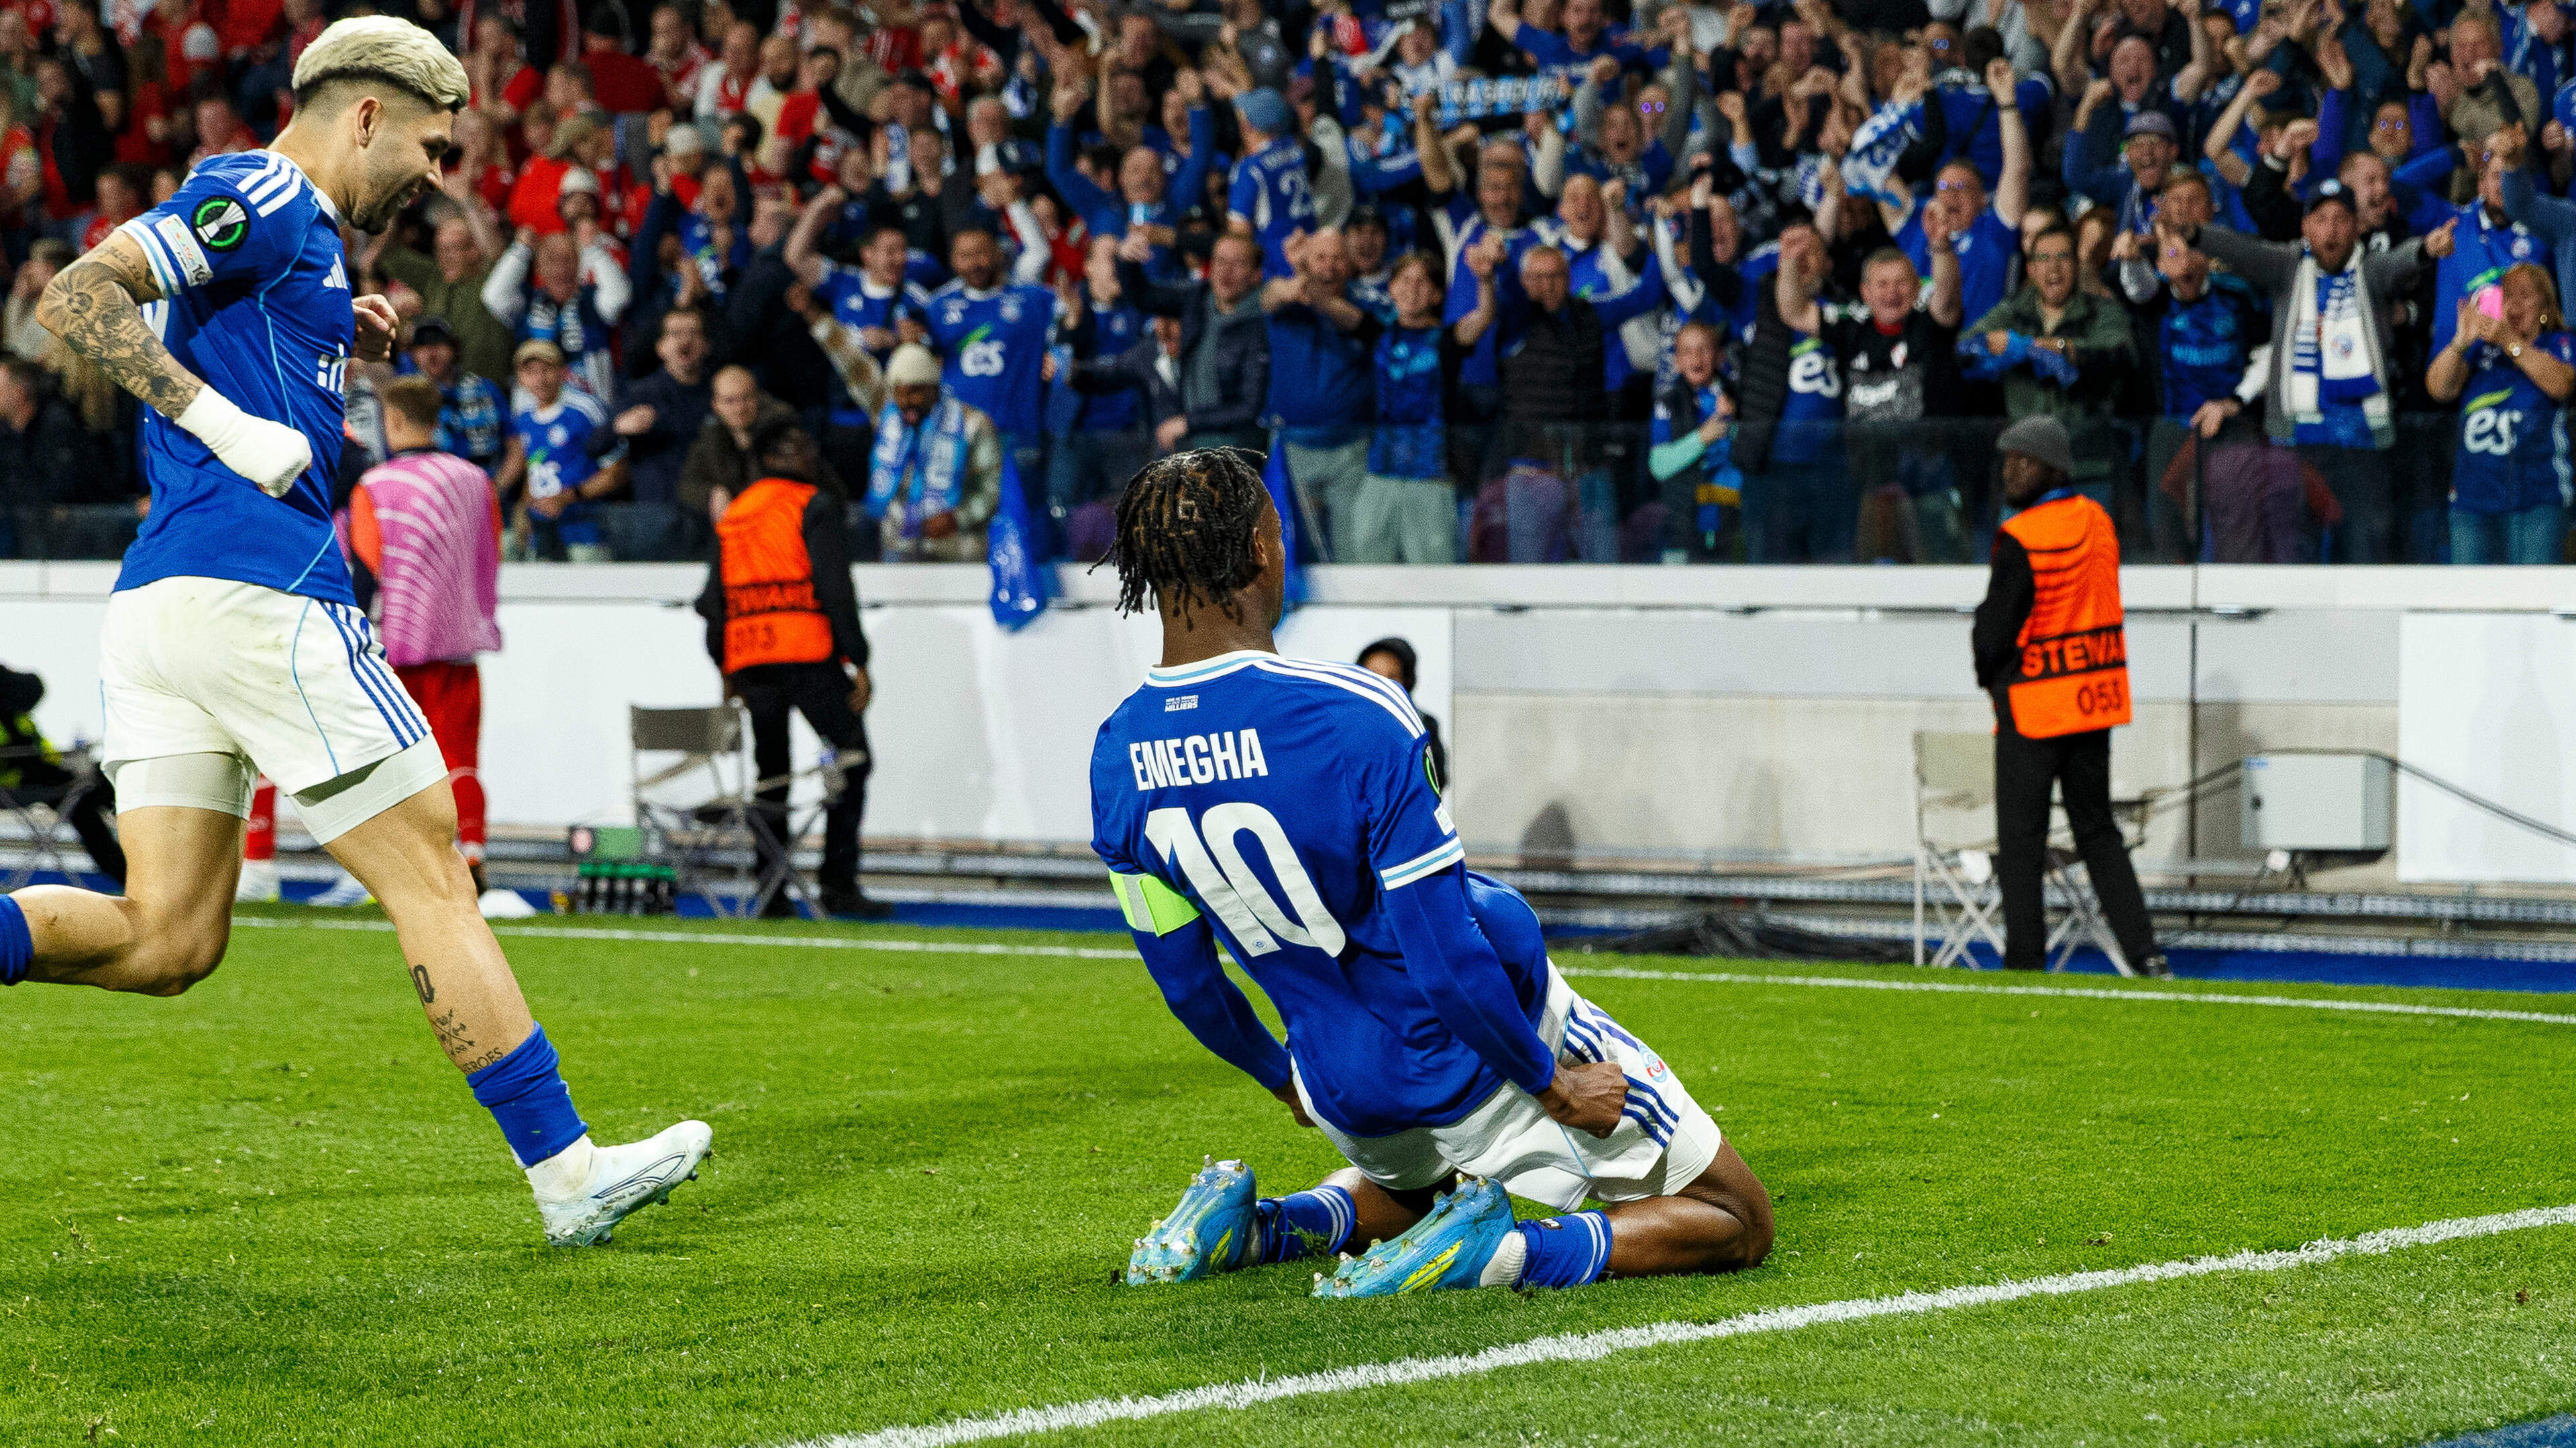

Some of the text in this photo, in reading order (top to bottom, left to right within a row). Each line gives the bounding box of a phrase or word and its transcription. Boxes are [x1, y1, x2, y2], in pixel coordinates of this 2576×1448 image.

[1164, 702, 1199, 712] MILLIERS
[1129, 728, 1269, 791] EMEGHA
[1144, 802, 1346, 958] 10
